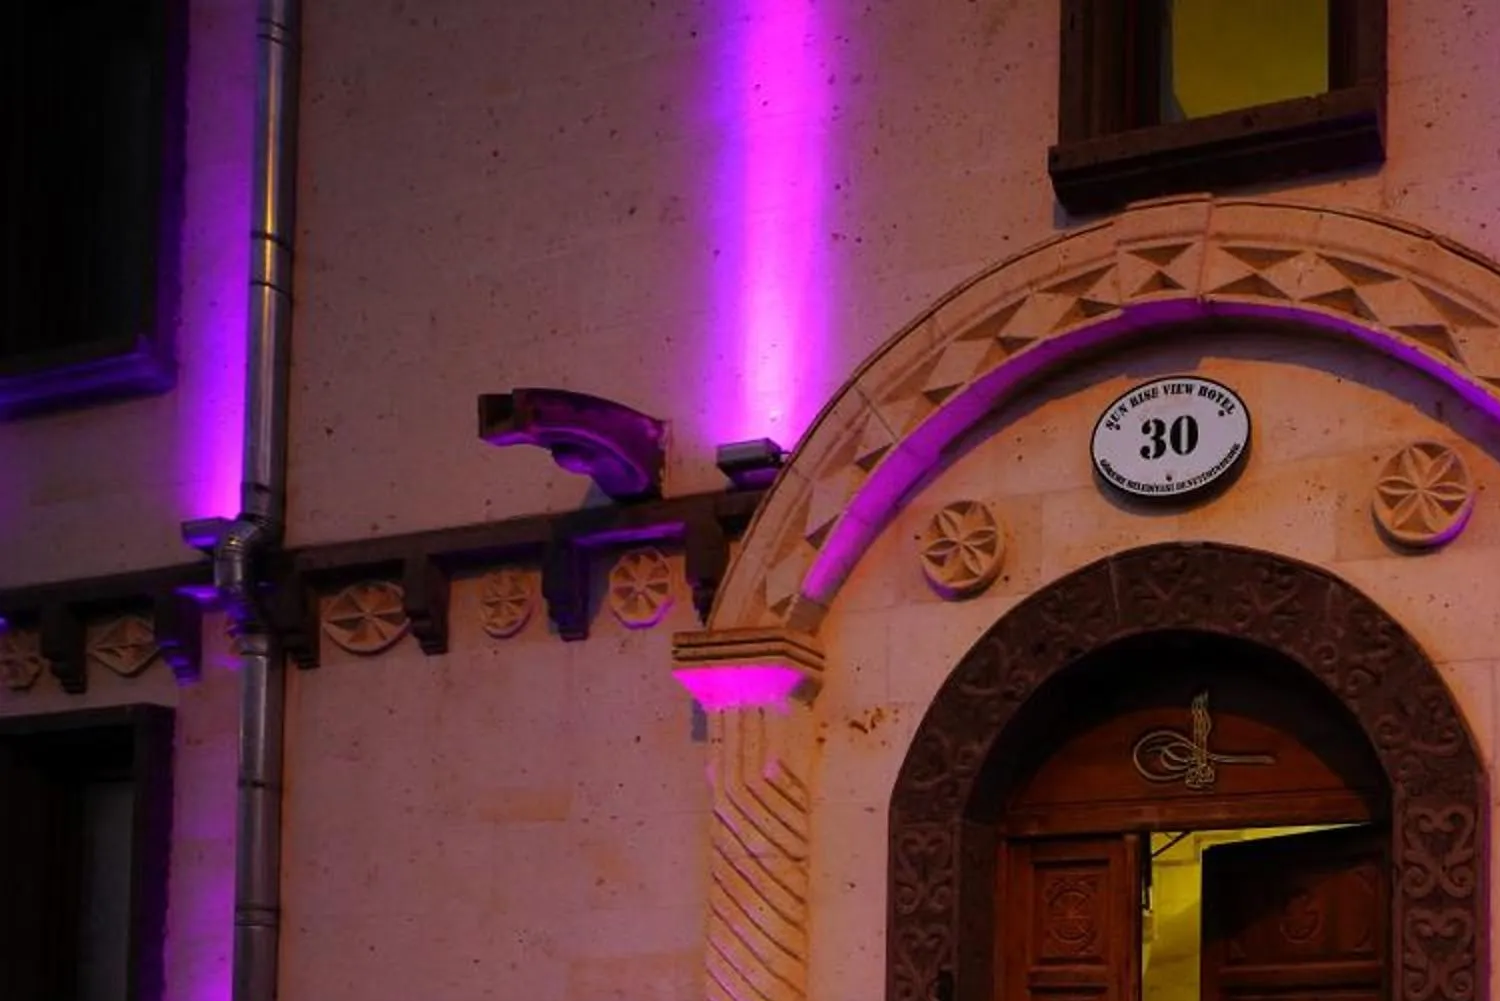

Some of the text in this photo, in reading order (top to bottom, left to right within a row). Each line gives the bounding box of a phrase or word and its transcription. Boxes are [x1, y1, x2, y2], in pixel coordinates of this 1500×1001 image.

[1105, 383, 1236, 430] SUN RISE VIEW HOTEL
[1140, 415, 1199, 460] 30
